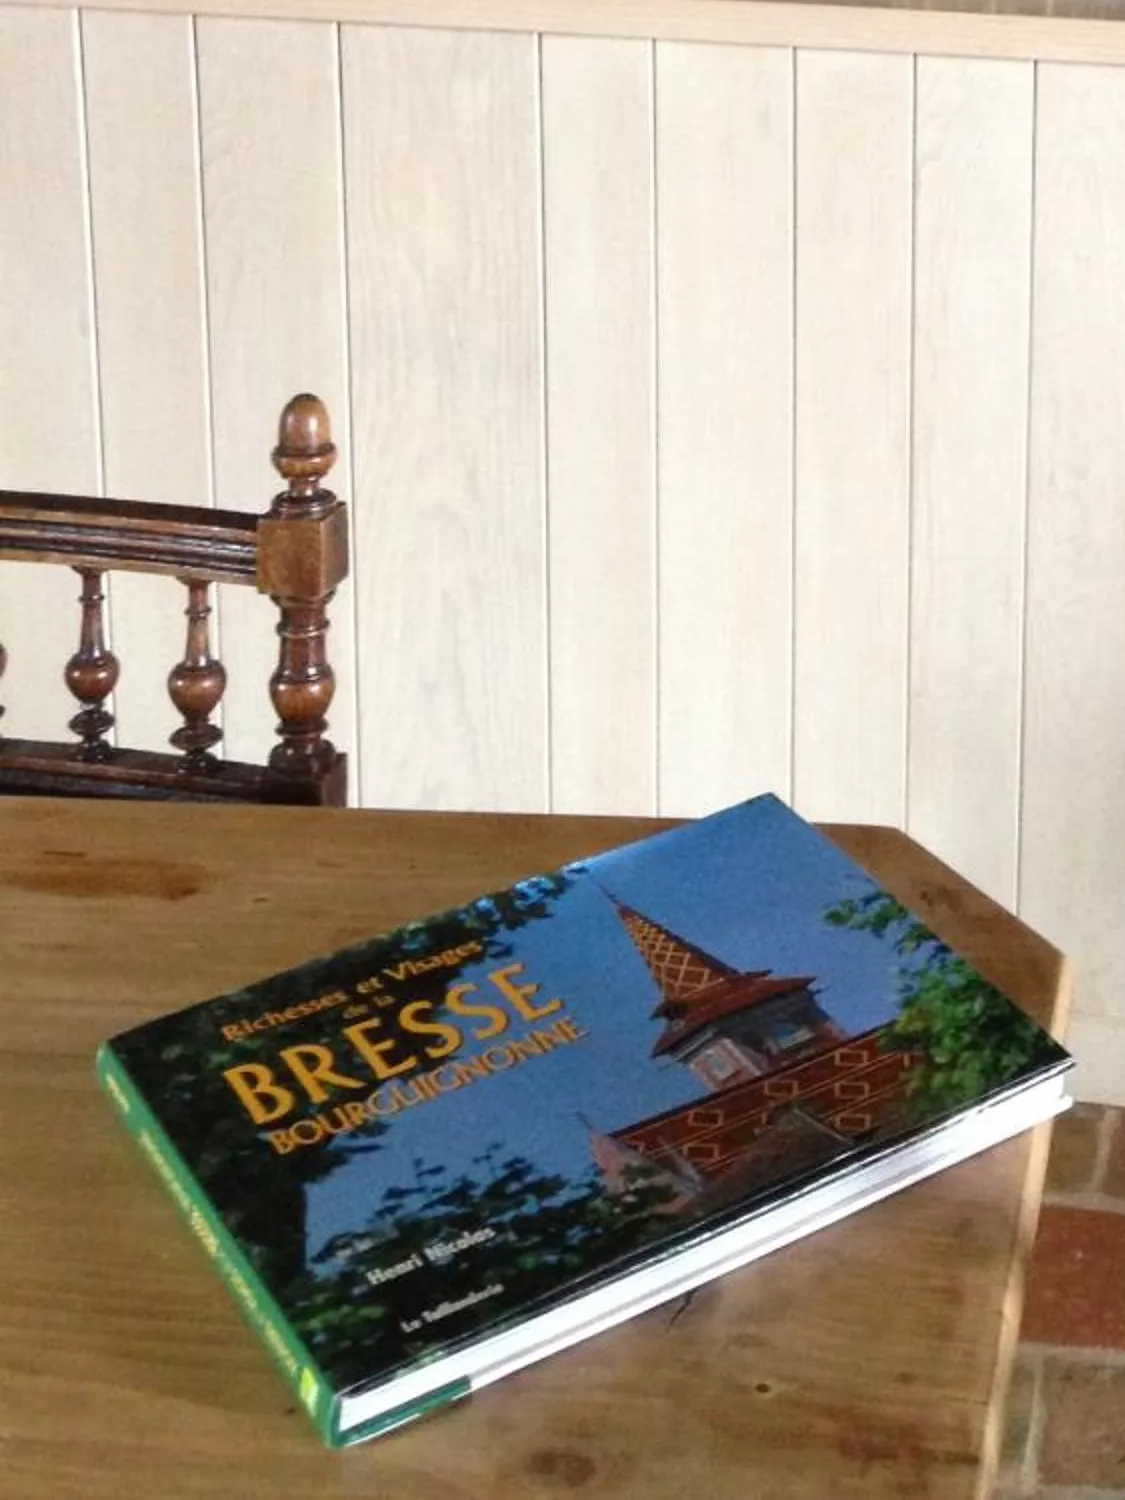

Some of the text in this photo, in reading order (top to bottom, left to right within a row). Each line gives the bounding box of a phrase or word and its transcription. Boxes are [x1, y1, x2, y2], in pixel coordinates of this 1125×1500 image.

[221, 938, 484, 1043] Richesses et Visages
[222, 963, 565, 1125] BRESSE
[264, 1014, 590, 1156] BOURGUIGNONNE
[365, 1252, 424, 1286] Henri
